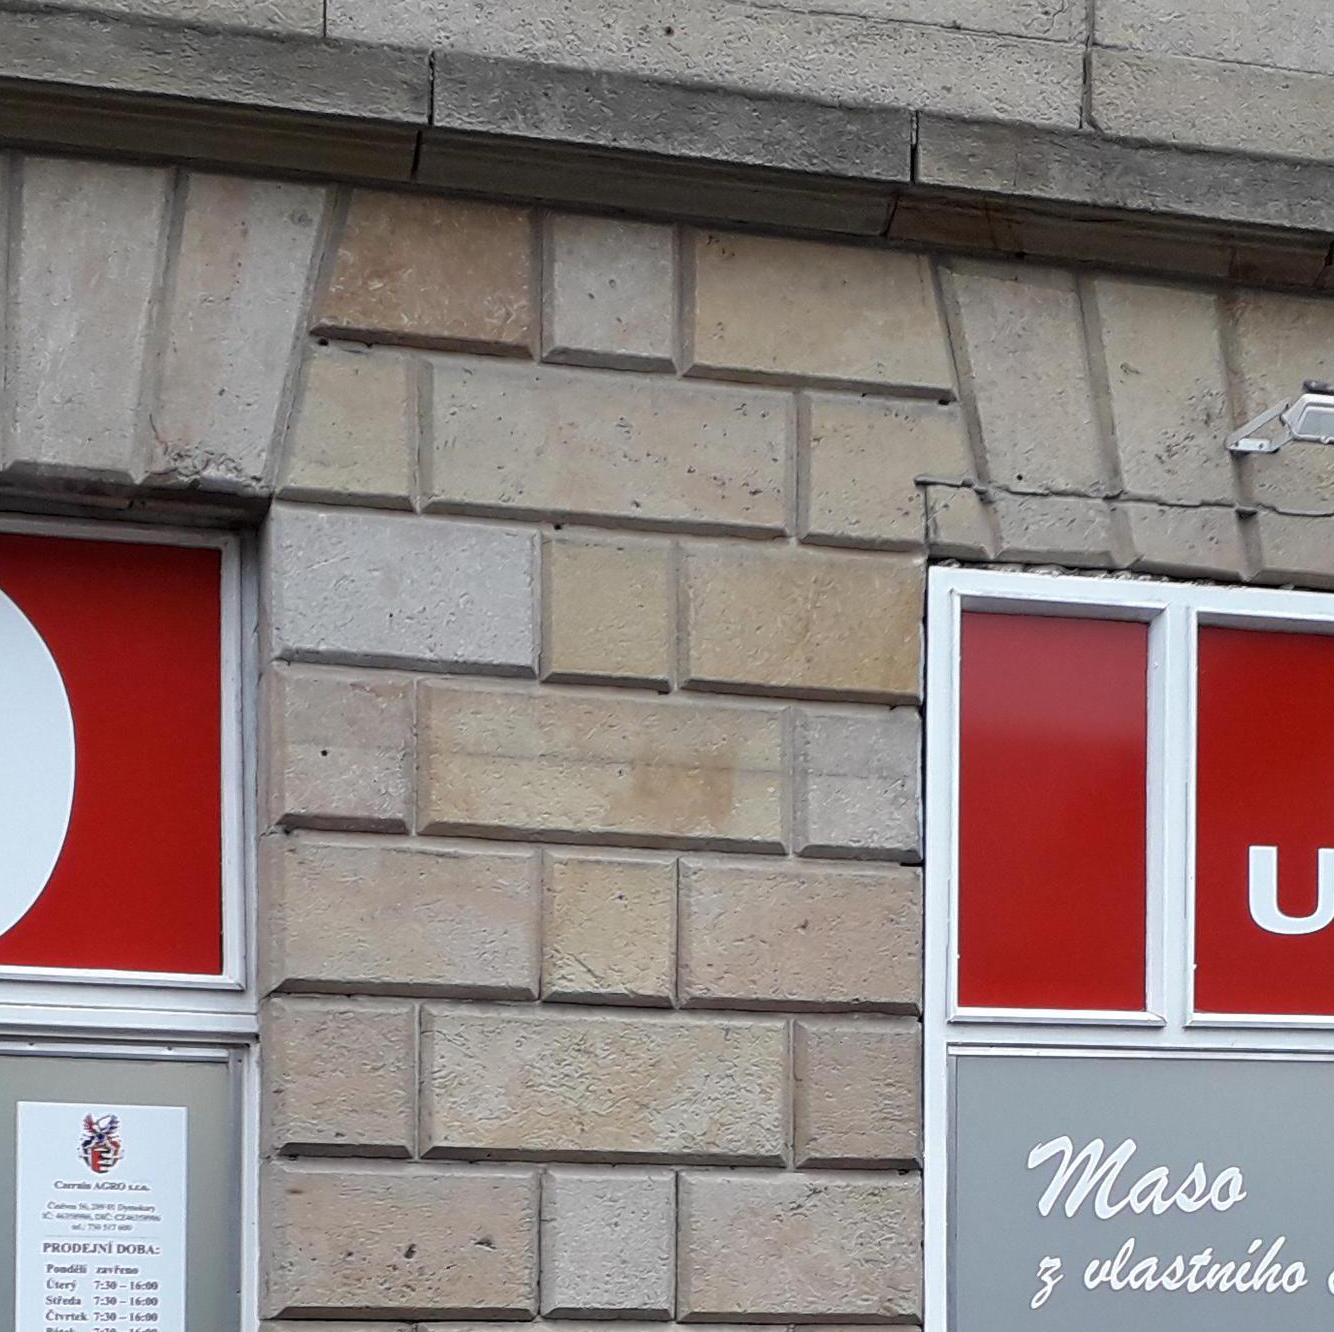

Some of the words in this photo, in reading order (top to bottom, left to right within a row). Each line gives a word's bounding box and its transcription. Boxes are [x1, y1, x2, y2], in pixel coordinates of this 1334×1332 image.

[1027, 1134, 1247, 1220] Maso
[42, 1241, 114, 1255] PRODEJNÍ
[116, 1243, 161, 1255] DOBA:
[46, 1263, 88, 1274] Pondělí
[95, 1265, 139, 1275] zavřeno
[1030, 1255, 1065, 1310] z
[1083, 1235, 1309, 1295] vlastního
[45, 1278, 76, 1292] Úterý
[93, 1280, 117, 1290] 7:30
[129, 1281, 158, 1291] 16:00
[45, 1295, 82, 1306] Středa
[93, 1296, 117, 1306] 7:30
[129, 1297, 158, 1307] 16:00
[45, 1309, 88, 1321] Čtvrtek
[93, 1312, 117, 1322] 7:30
[129, 1313, 158, 1323] 16:00
